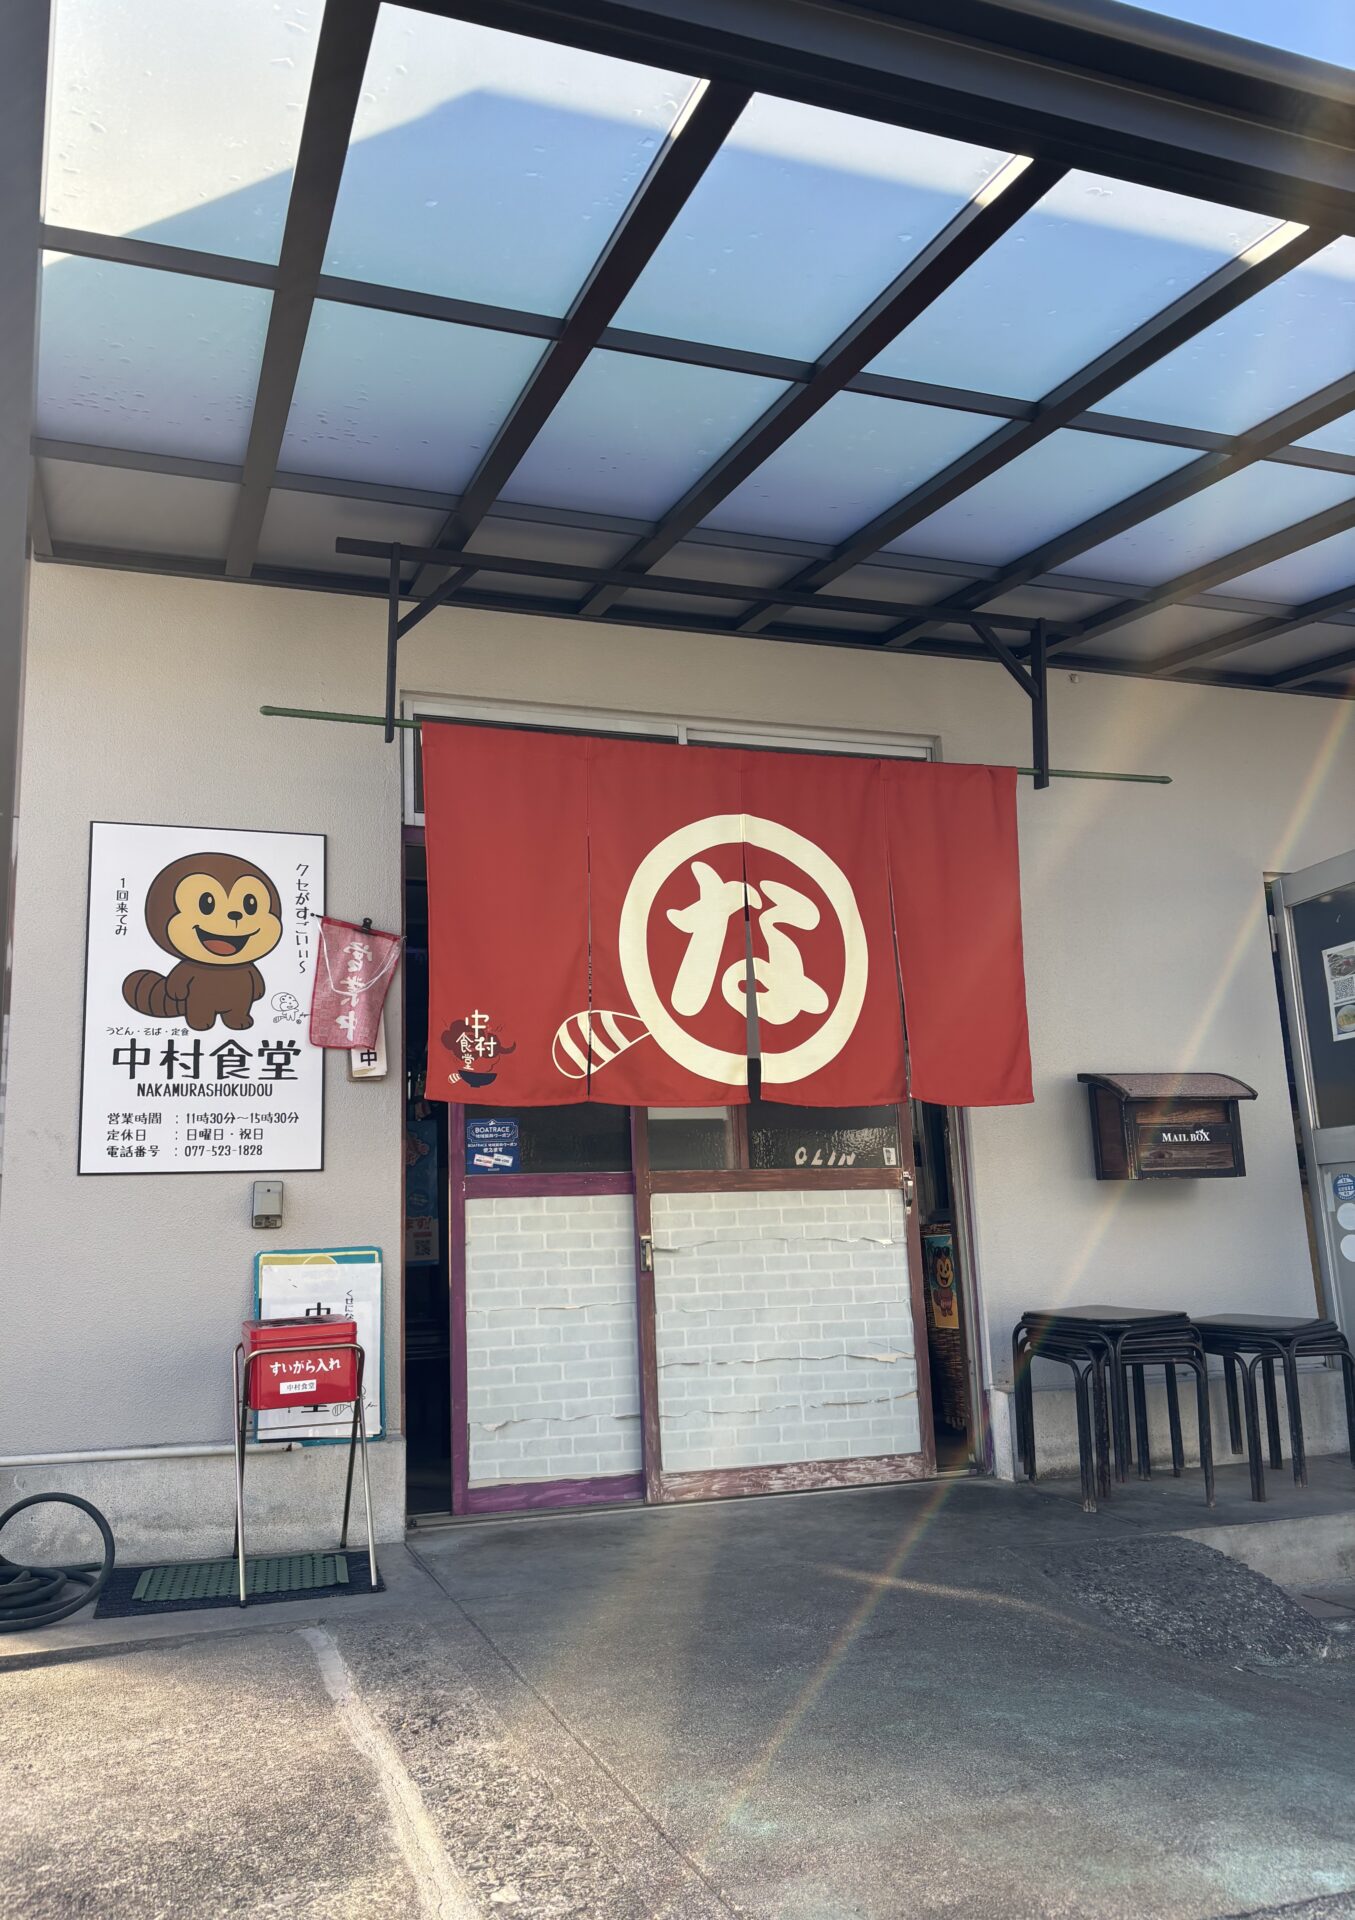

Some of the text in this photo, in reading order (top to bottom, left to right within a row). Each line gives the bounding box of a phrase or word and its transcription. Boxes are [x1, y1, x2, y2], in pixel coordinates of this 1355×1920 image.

[115, 877, 129, 936] 1回来てみ
[666, 861, 829, 1025] な
[106, 1026, 190, 1037] うどん・そば・定食
[112, 1037, 302, 1080] 中村食堂
[137, 1082, 273, 1098] NAKAMURASHOKUDOU
[107, 1112, 162, 1125] 営業時間
[106, 1128, 146, 1141] 定休日
[1162, 1132, 1189, 1142] MAIL
[106, 1144, 160, 1157] 電話番号
[184, 1144, 263, 1157] 077-523-1828
[269, 1358, 341, 1376] すいがら入れ
